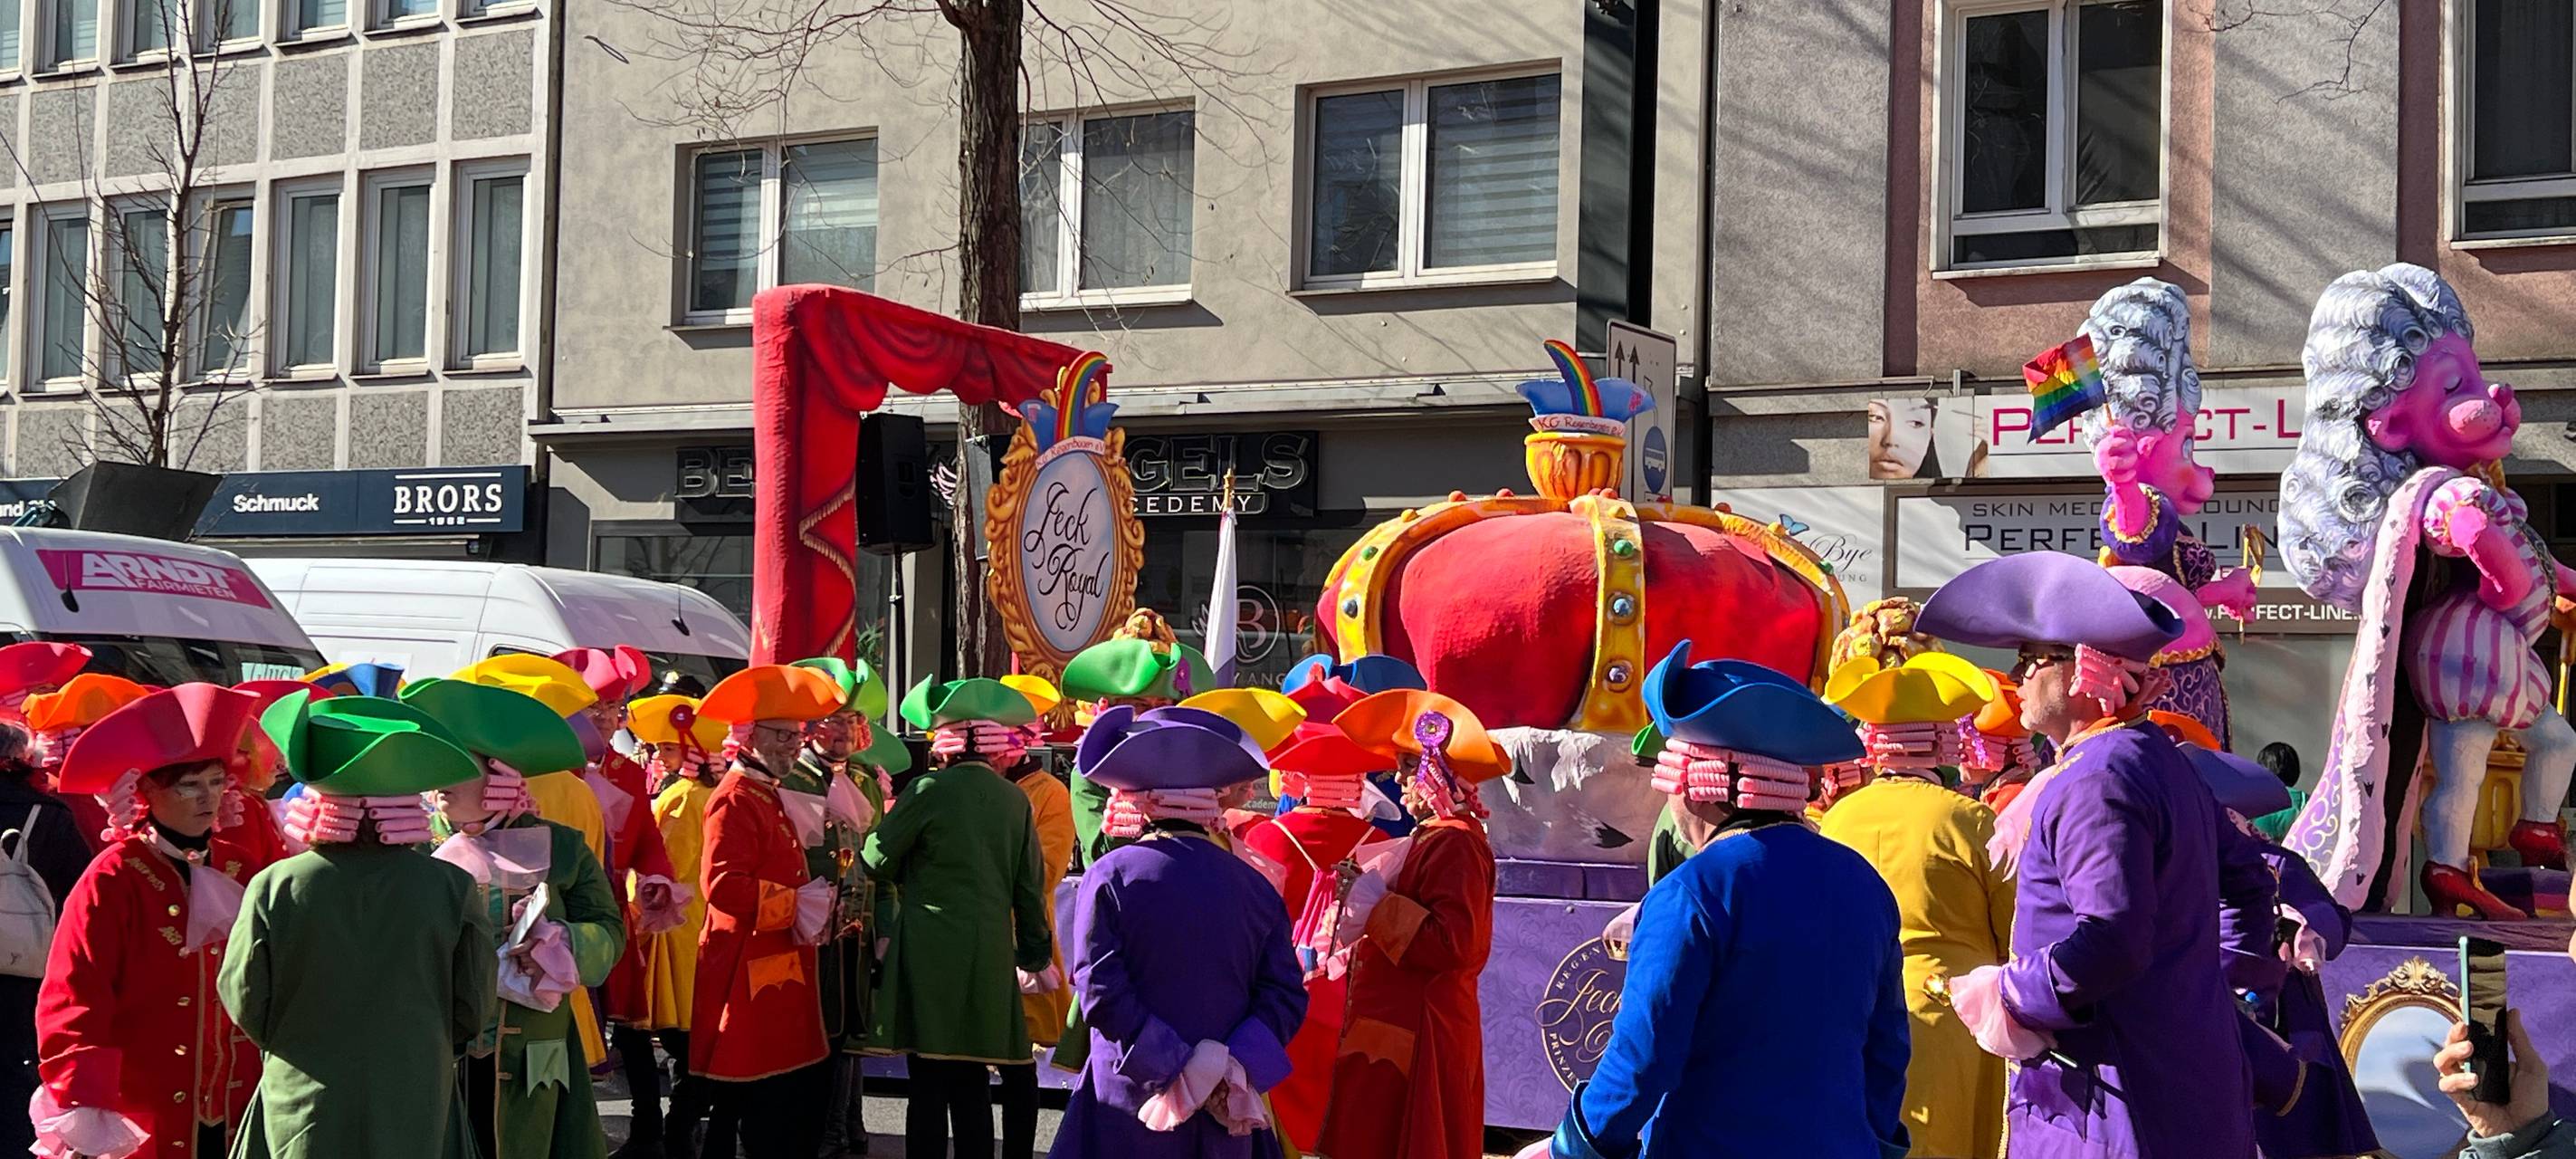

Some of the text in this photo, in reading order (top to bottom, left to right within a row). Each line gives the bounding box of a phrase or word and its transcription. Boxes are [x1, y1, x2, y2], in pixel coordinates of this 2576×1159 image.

[233, 493, 319, 513] Schmuck
[393, 483, 502, 514] BRORS
[1972, 503, 2034, 518] SKIN
[81, 552, 230, 589] ARNDT
[133, 578, 237, 599] FAIRMIETEN
[1038, 543, 1110, 632] Royal
